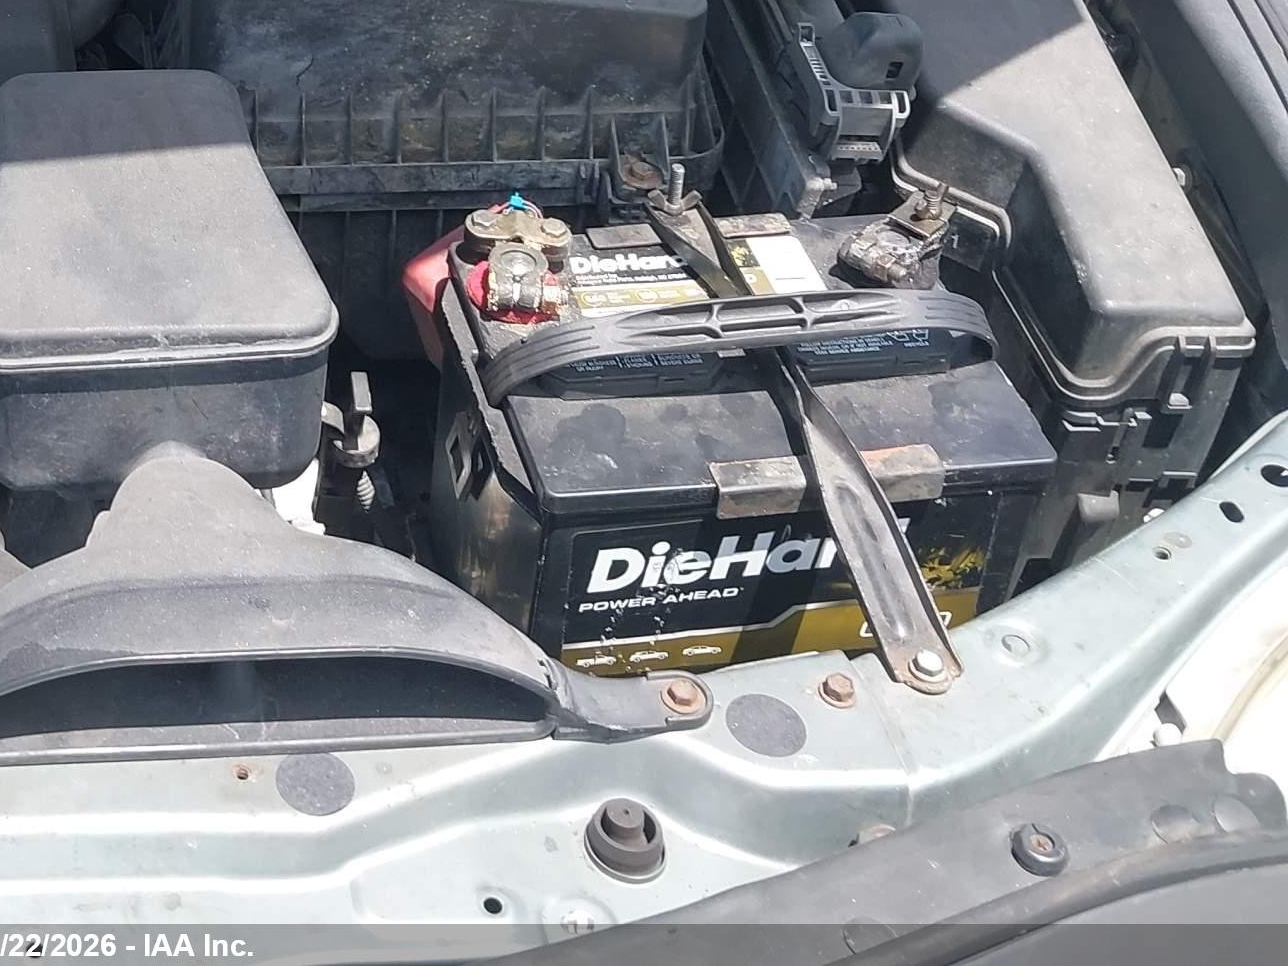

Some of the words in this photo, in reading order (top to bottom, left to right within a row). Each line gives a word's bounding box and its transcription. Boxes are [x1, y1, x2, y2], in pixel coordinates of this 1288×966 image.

[587, 518, 911, 594] DieHar
[579, 596, 657, 613] POWER
[662, 587, 740, 604] AHEAD
